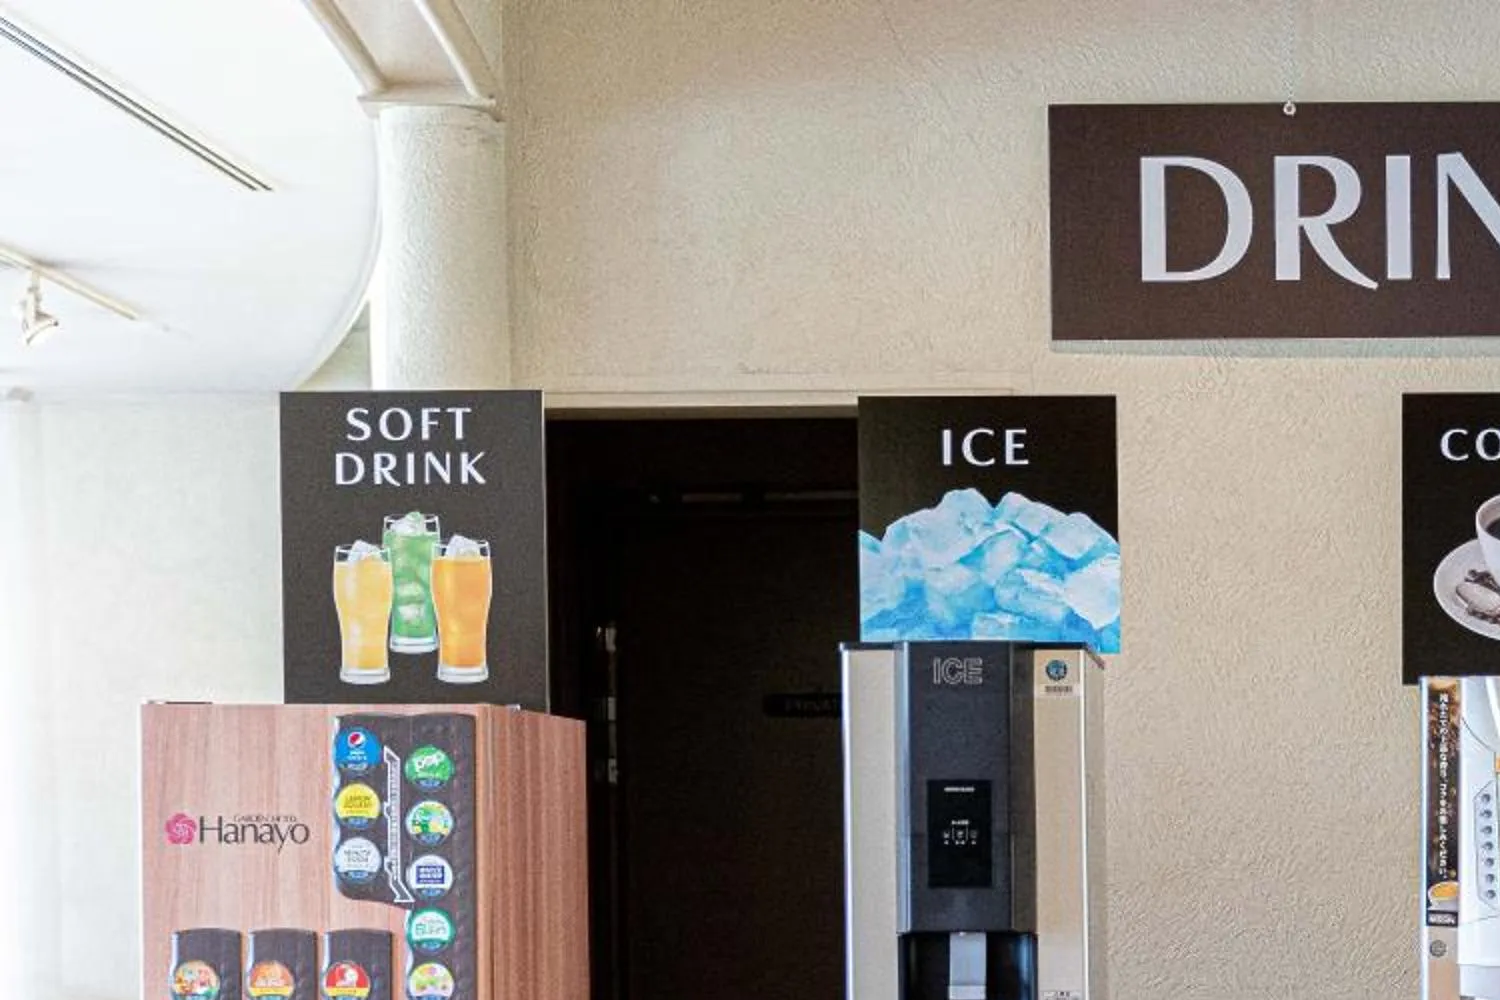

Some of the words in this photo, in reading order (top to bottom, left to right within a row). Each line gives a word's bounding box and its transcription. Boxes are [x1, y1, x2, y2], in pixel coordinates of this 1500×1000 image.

[346, 407, 472, 442] SOFT
[942, 427, 1029, 467] ICE
[335, 451, 486, 487] DRINK
[932, 656, 984, 685] ICE
[199, 815, 311, 855] Hanayo
